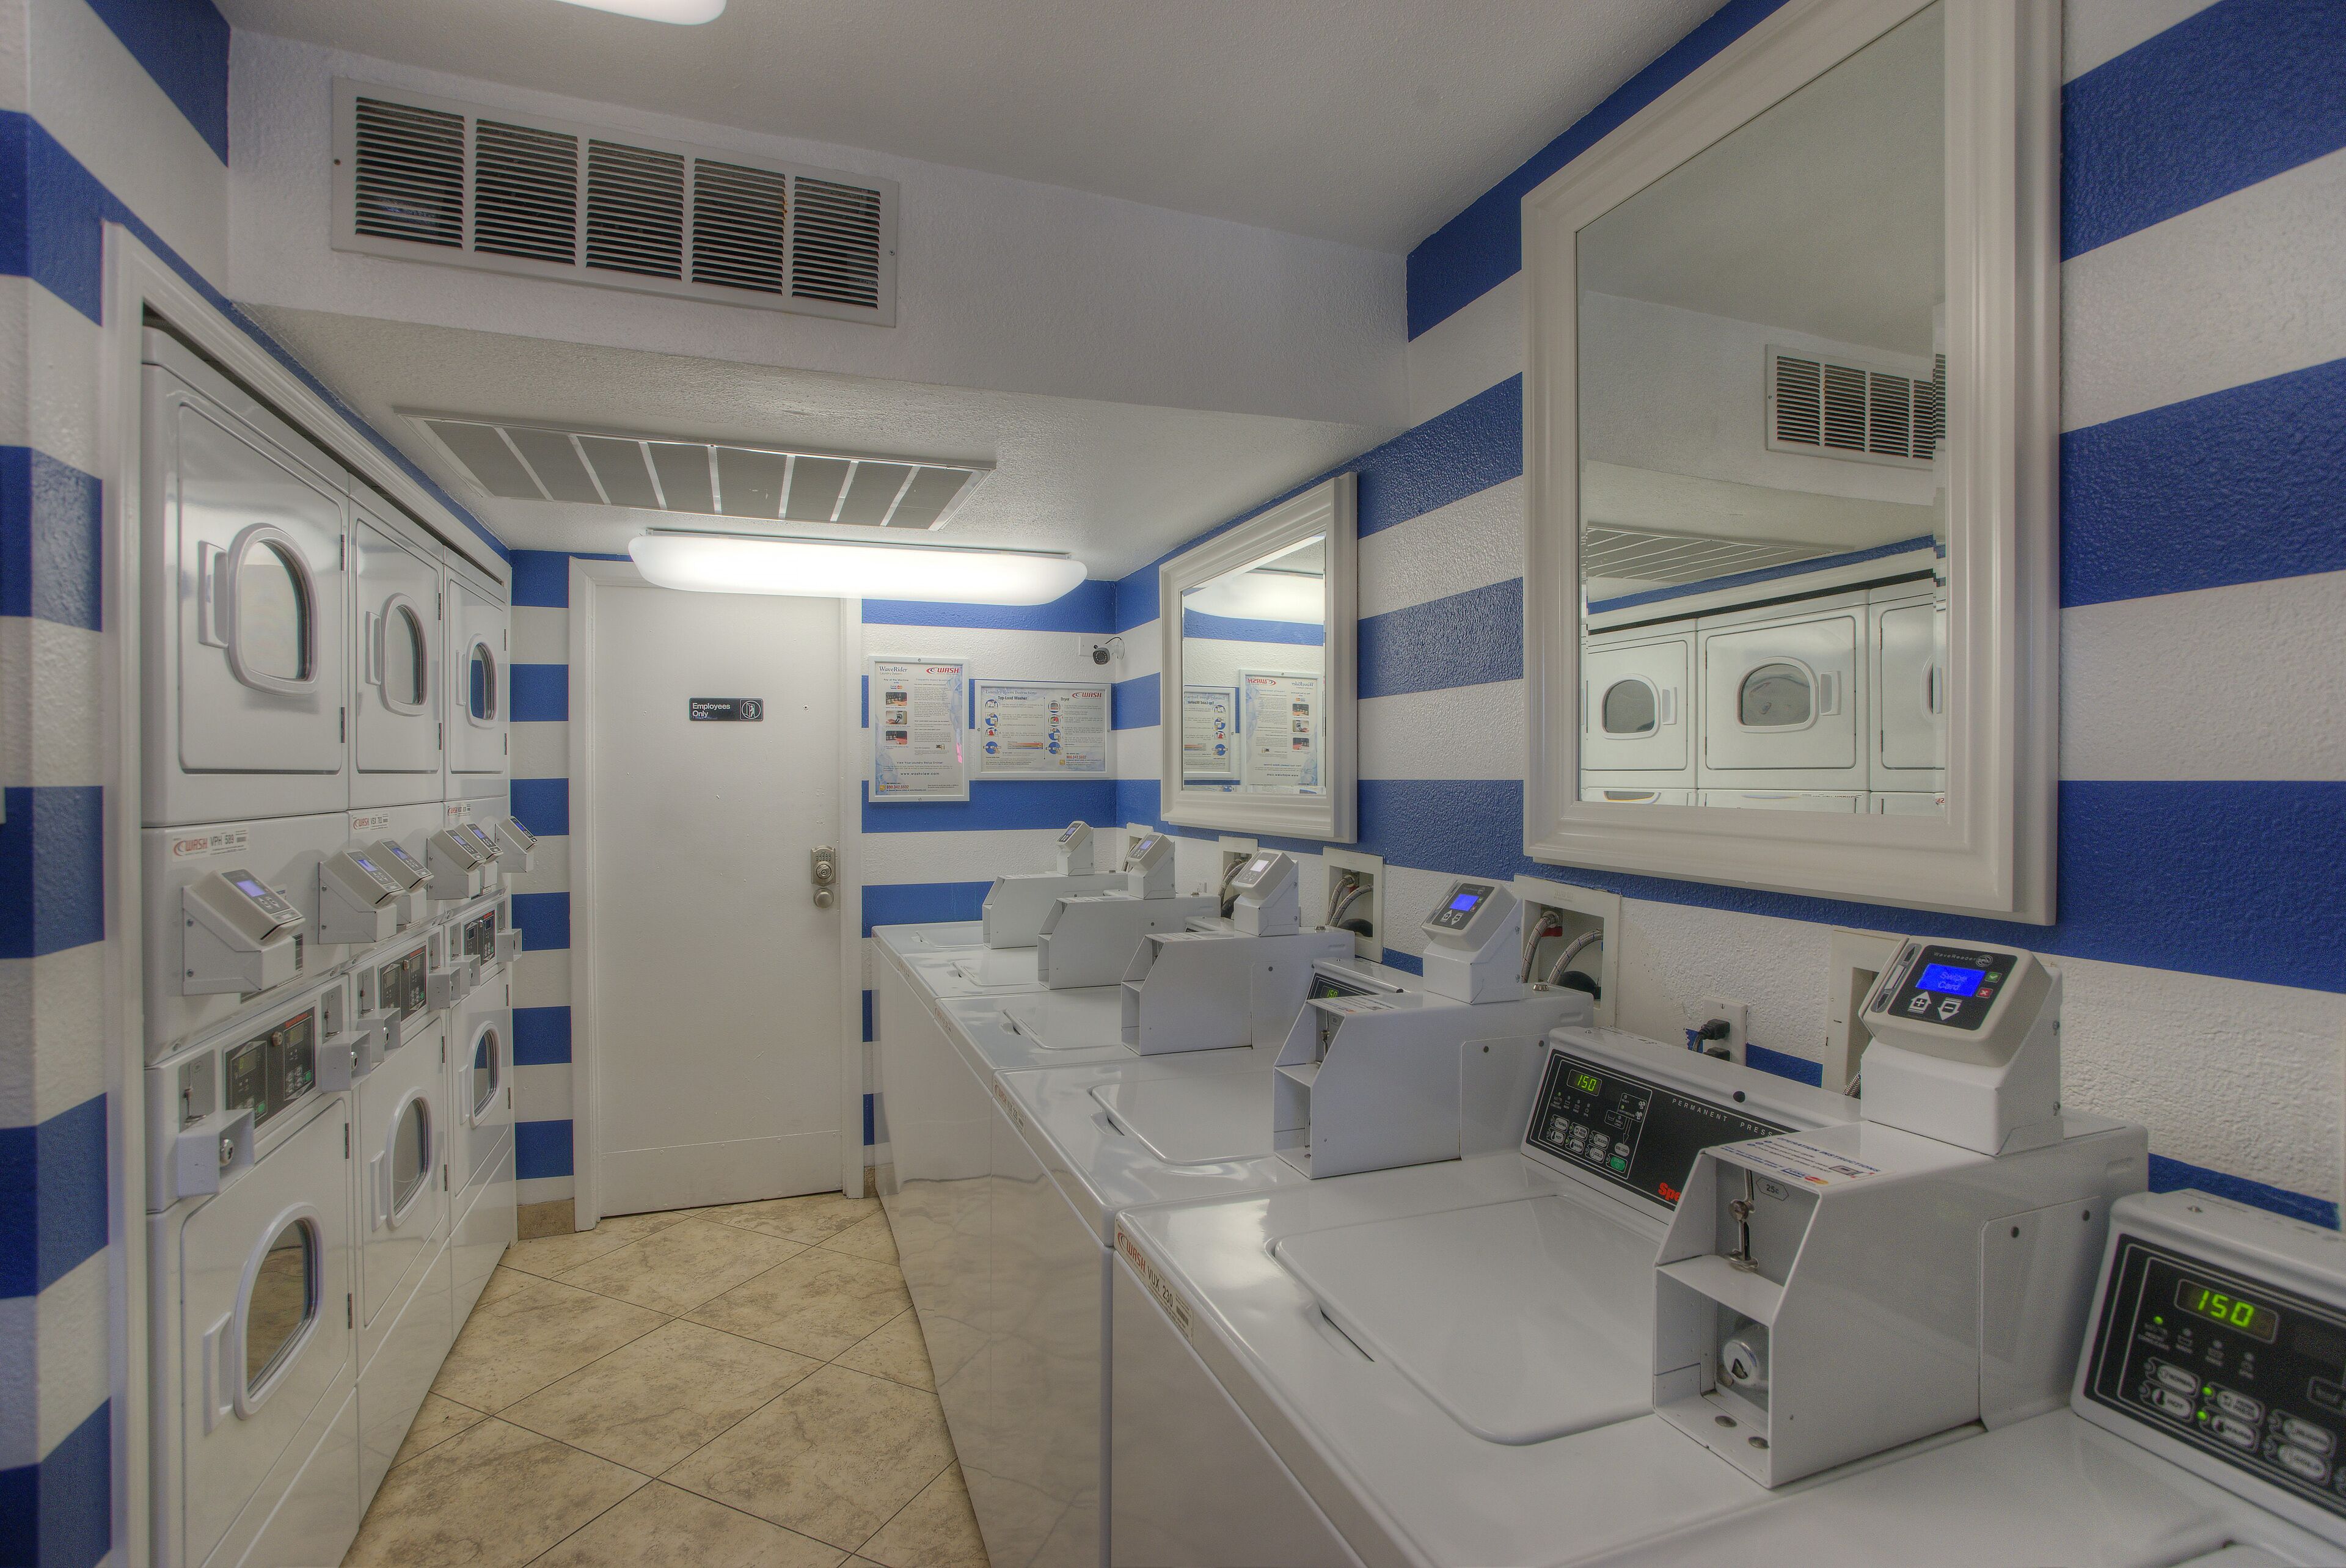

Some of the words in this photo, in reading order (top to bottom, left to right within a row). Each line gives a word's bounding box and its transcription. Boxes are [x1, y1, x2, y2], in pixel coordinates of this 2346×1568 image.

[186, 838, 208, 851] WASH
[210, 836, 222, 847] VPH
[1577, 1074, 1597, 1092] 150
[1672, 1098, 1728, 1122] PERMANENT
[1740, 1121, 1772, 1137] PRESS
[1820, 1151, 1880, 1172] INSTRUCTIONS
[1658, 1182, 1681, 1202] Spe
[1126, 1240, 1146, 1273] WASH
[1147, 1265, 1160, 1291] VUX
[1162, 1285, 1173, 1307] 230
[2198, 1289, 2255, 1329] 150
